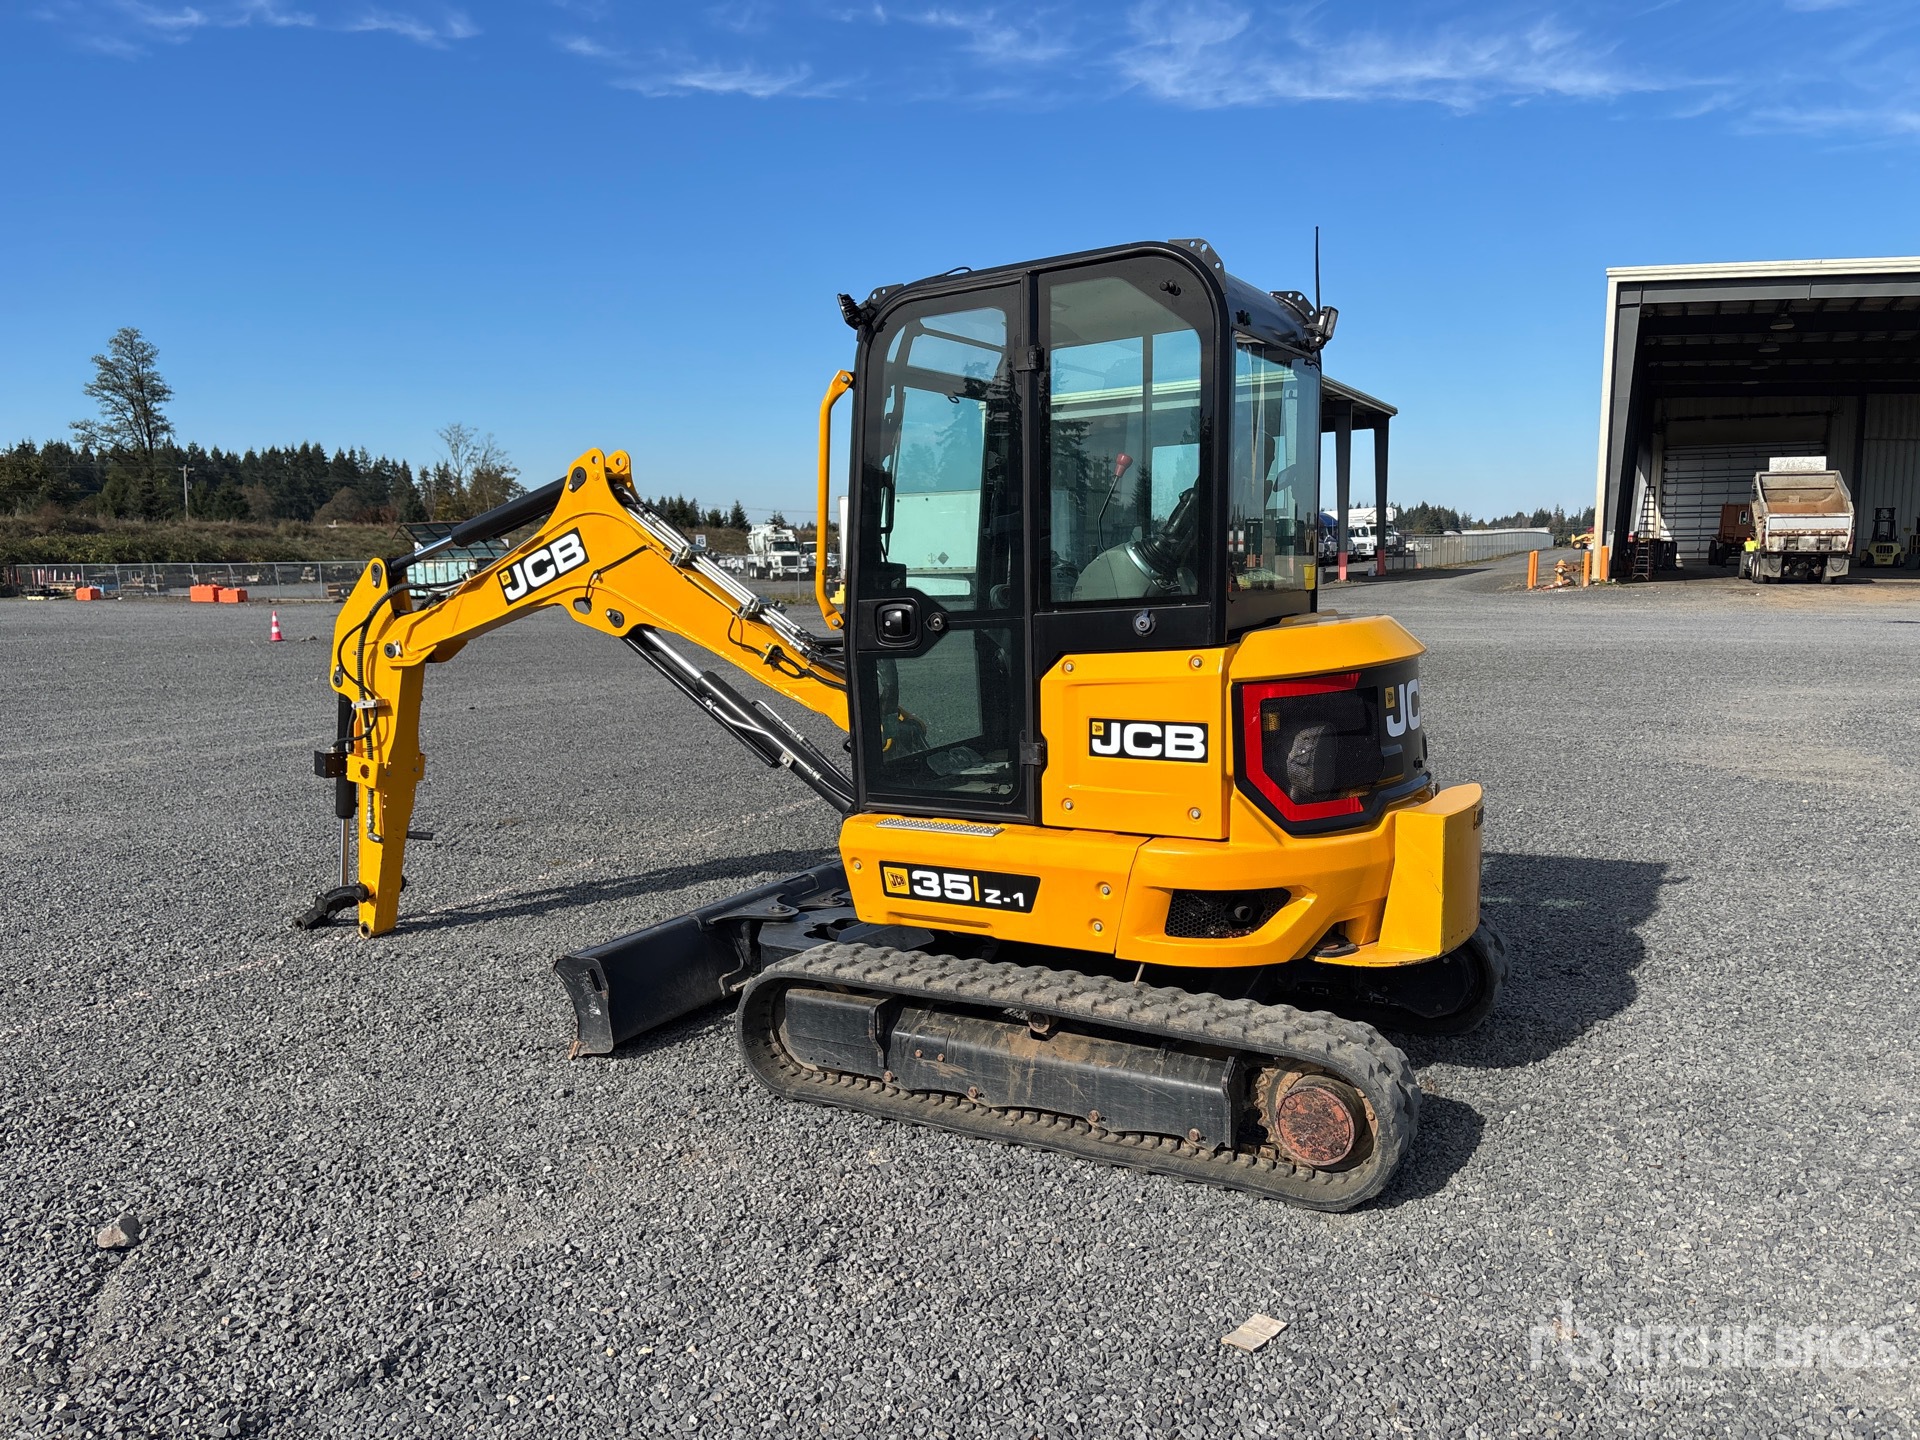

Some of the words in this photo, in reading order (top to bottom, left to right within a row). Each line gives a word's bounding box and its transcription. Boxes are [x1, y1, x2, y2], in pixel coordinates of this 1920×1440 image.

[504, 533, 586, 601] JCB
[1385, 678, 1421, 738] JC
[1091, 722, 1206, 759] JCB
